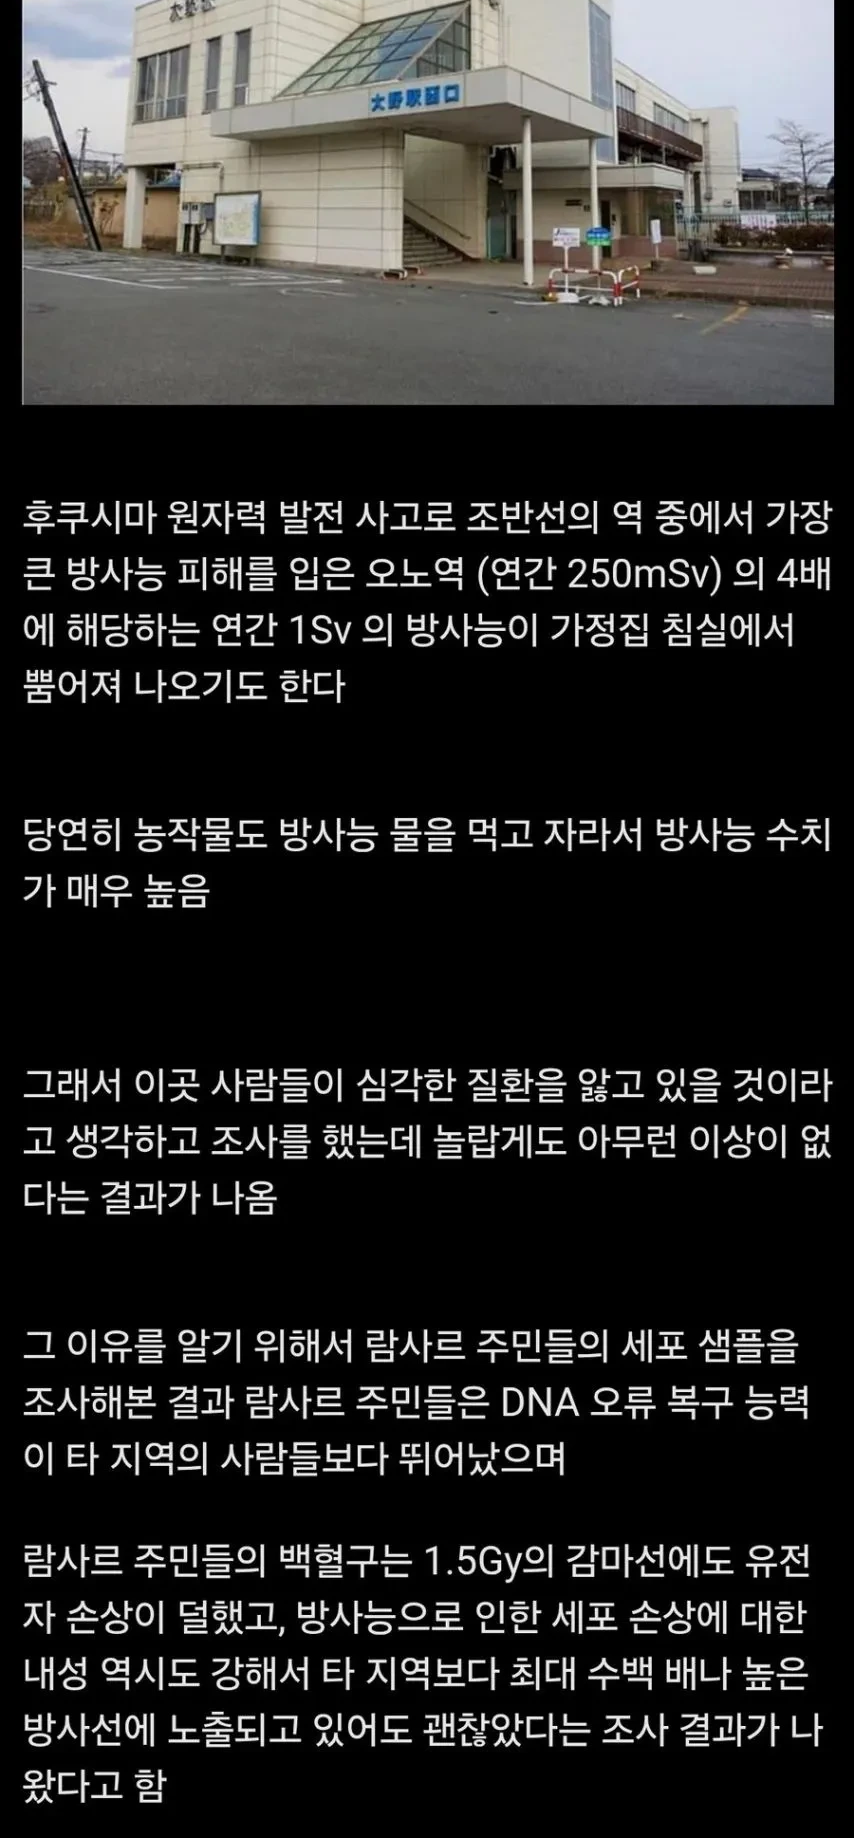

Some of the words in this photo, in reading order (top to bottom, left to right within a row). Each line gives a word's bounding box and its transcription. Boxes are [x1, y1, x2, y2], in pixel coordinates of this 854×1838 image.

[25, 1442, 52, 1476] 이
[68, 1442, 99, 1475] 타
[111, 1442, 207, 1476] 지역의
[221, 1442, 389, 1476] 사람들보다
[400, 1442, 564, 1476] 뛰어났으며
